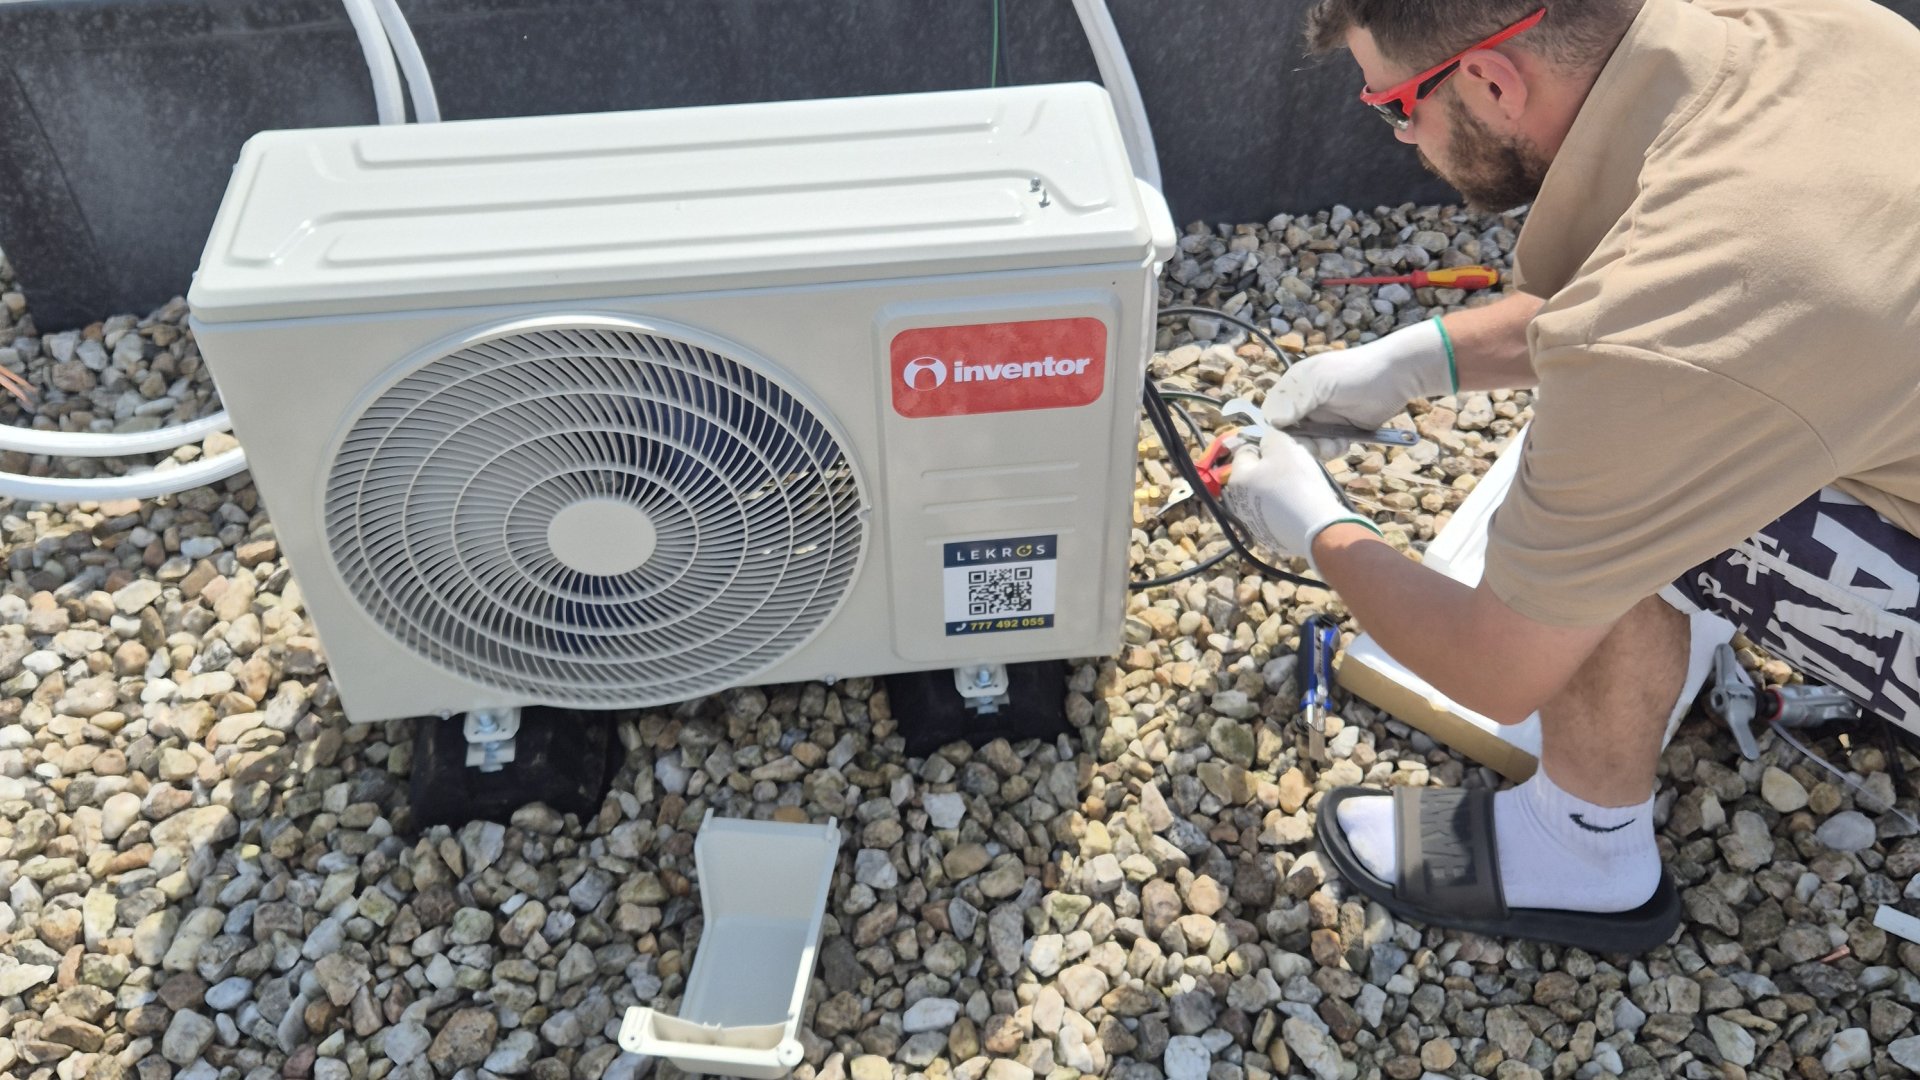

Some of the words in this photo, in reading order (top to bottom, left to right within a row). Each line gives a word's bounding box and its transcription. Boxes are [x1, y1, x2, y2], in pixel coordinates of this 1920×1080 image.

[953, 356, 1091, 383] inventor
[956, 544, 1046, 561] LEKROS
[970, 621, 993, 631] 777
[995, 619, 1018, 629] 492
[1021, 617, 1045, 627] 055
